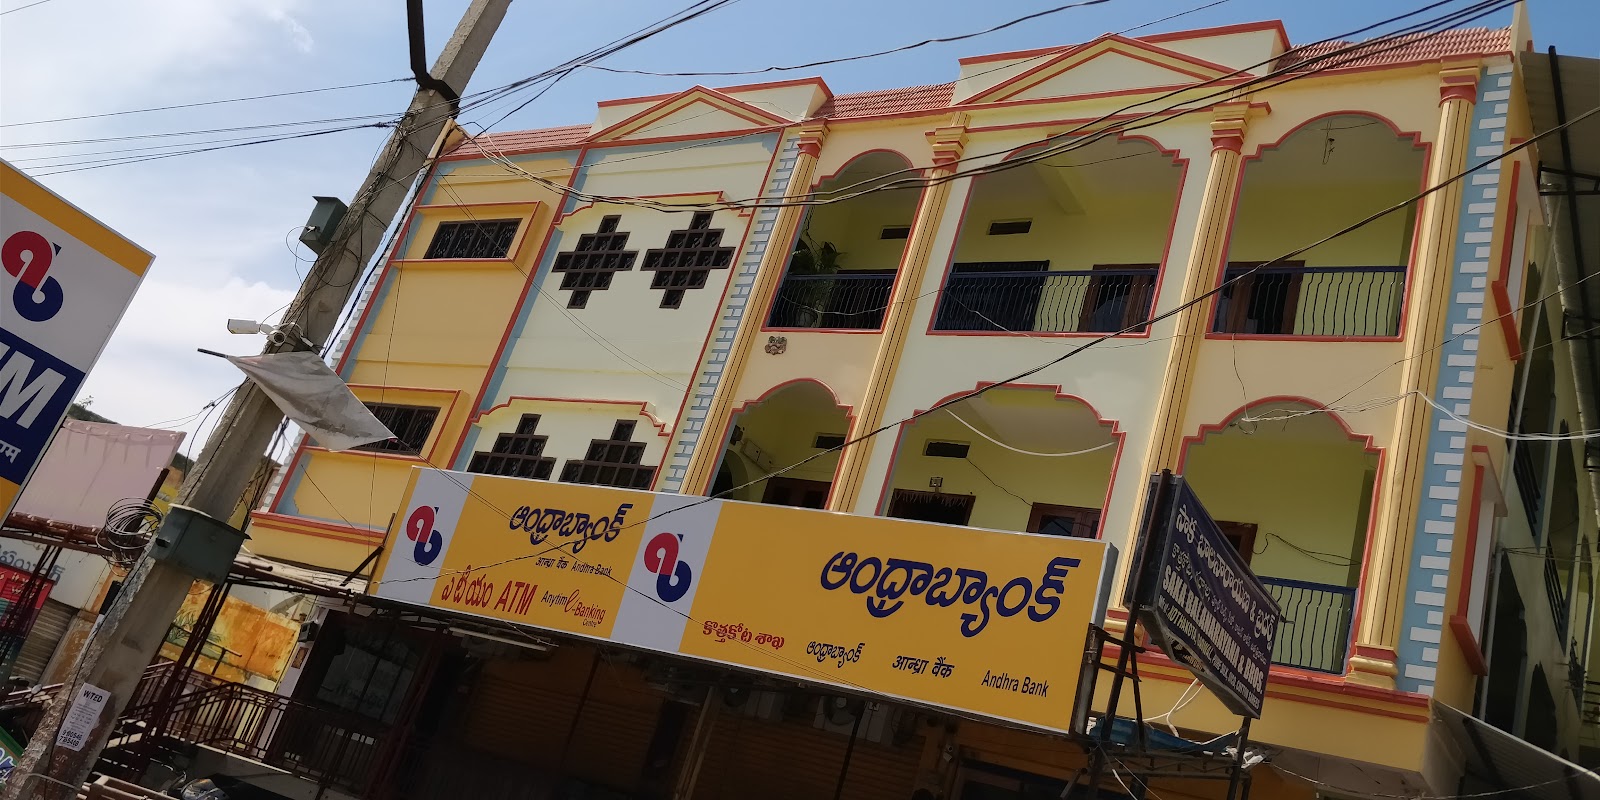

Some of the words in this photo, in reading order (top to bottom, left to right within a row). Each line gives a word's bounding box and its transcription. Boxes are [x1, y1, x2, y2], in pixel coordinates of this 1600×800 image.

[0, 341, 67, 429] M
[571, 561, 595, 574] Andhra
[594, 564, 612, 576] Bank
[494, 580, 538, 615] ATM
[821, 551, 1081, 638] ఆంధ్రాబ్యాంక్
[1163, 565, 1188, 609] SAKA
[1185, 590, 1241, 669] BALANARAYANA
[1237, 655, 1245, 674] &
[1250, 600, 1257, 622] &
[702, 620, 753, 643] కొత్తకోట
[755, 632, 785, 650] శాఖ
[806, 641, 866, 668] ఆంధ్రాబ్యాంక్
[931, 656, 955, 679] बैंक
[981, 669, 1019, 692] Andhra
[1021, 676, 1049, 698] Bank
